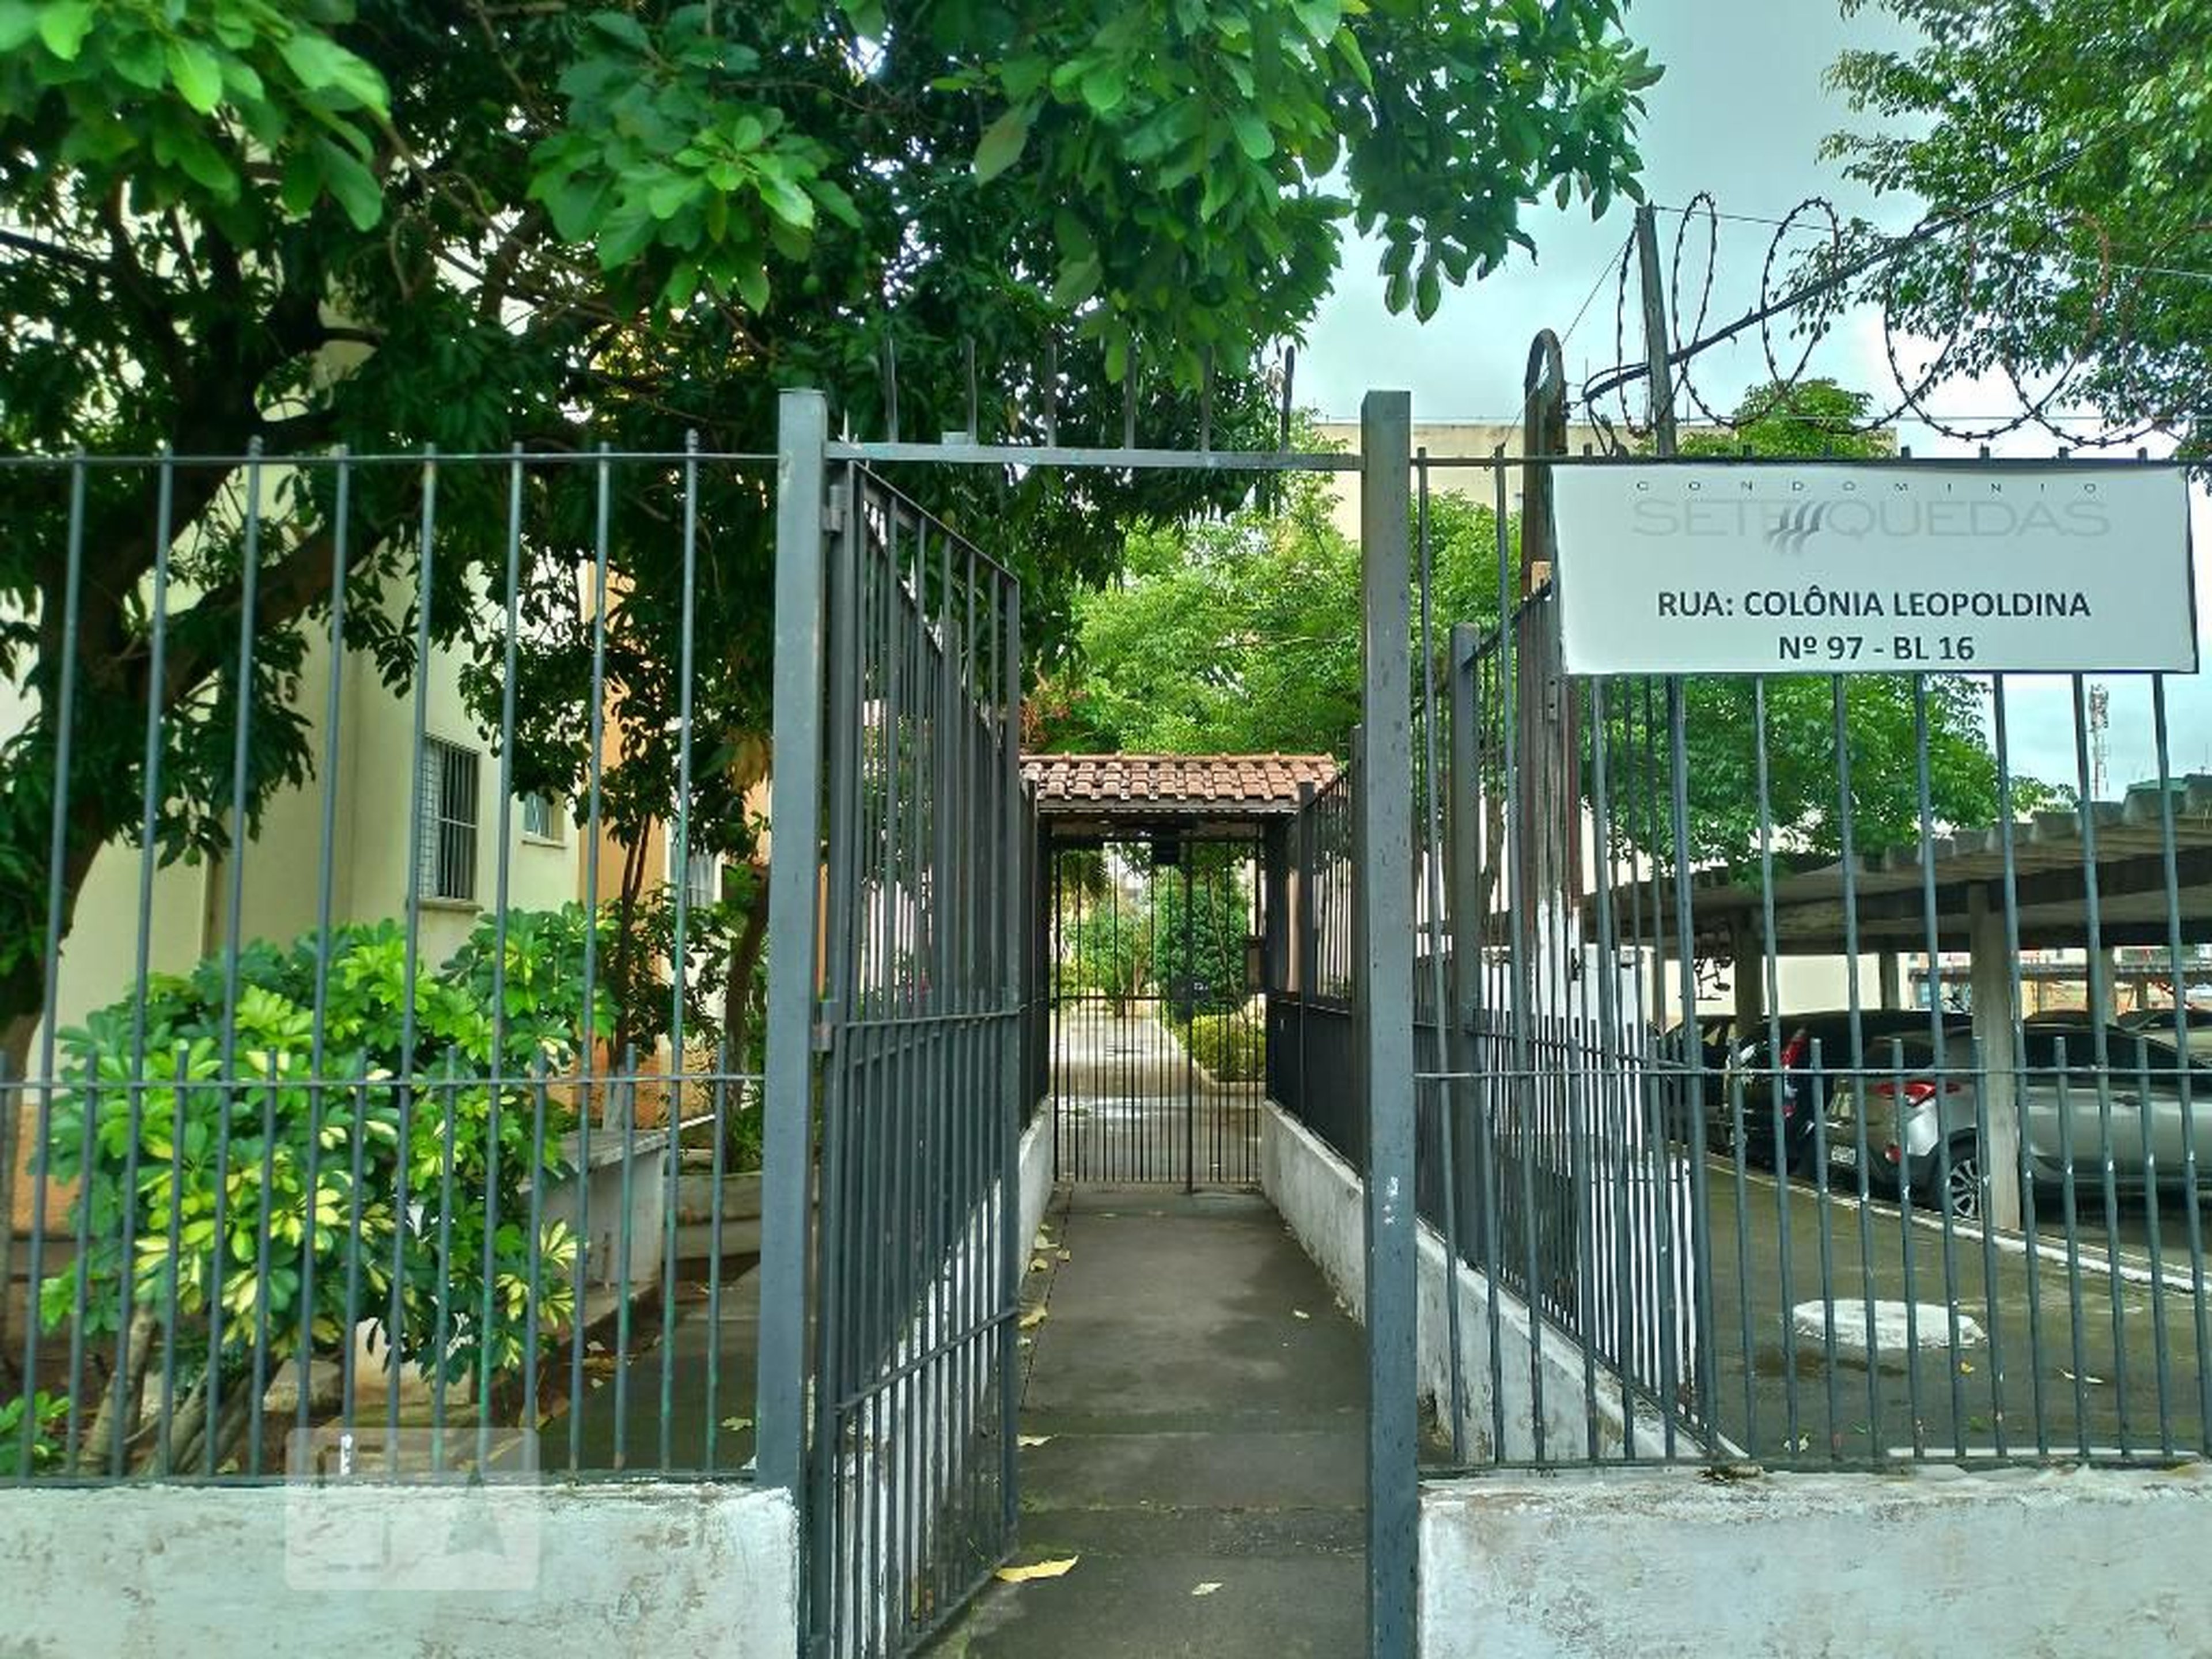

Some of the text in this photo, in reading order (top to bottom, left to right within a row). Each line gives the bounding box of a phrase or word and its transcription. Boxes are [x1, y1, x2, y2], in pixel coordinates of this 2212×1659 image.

[1827, 499, 2111, 540] QUEDAS
[1658, 584, 2091, 616] RUA: COLÔNIA LEOPOLDINA
[1779, 636, 1817, 660] Nº
[1827, 636, 1863, 660] 97
[1893, 636, 1929, 660] BL
[1939, 636, 1975, 660] 16
